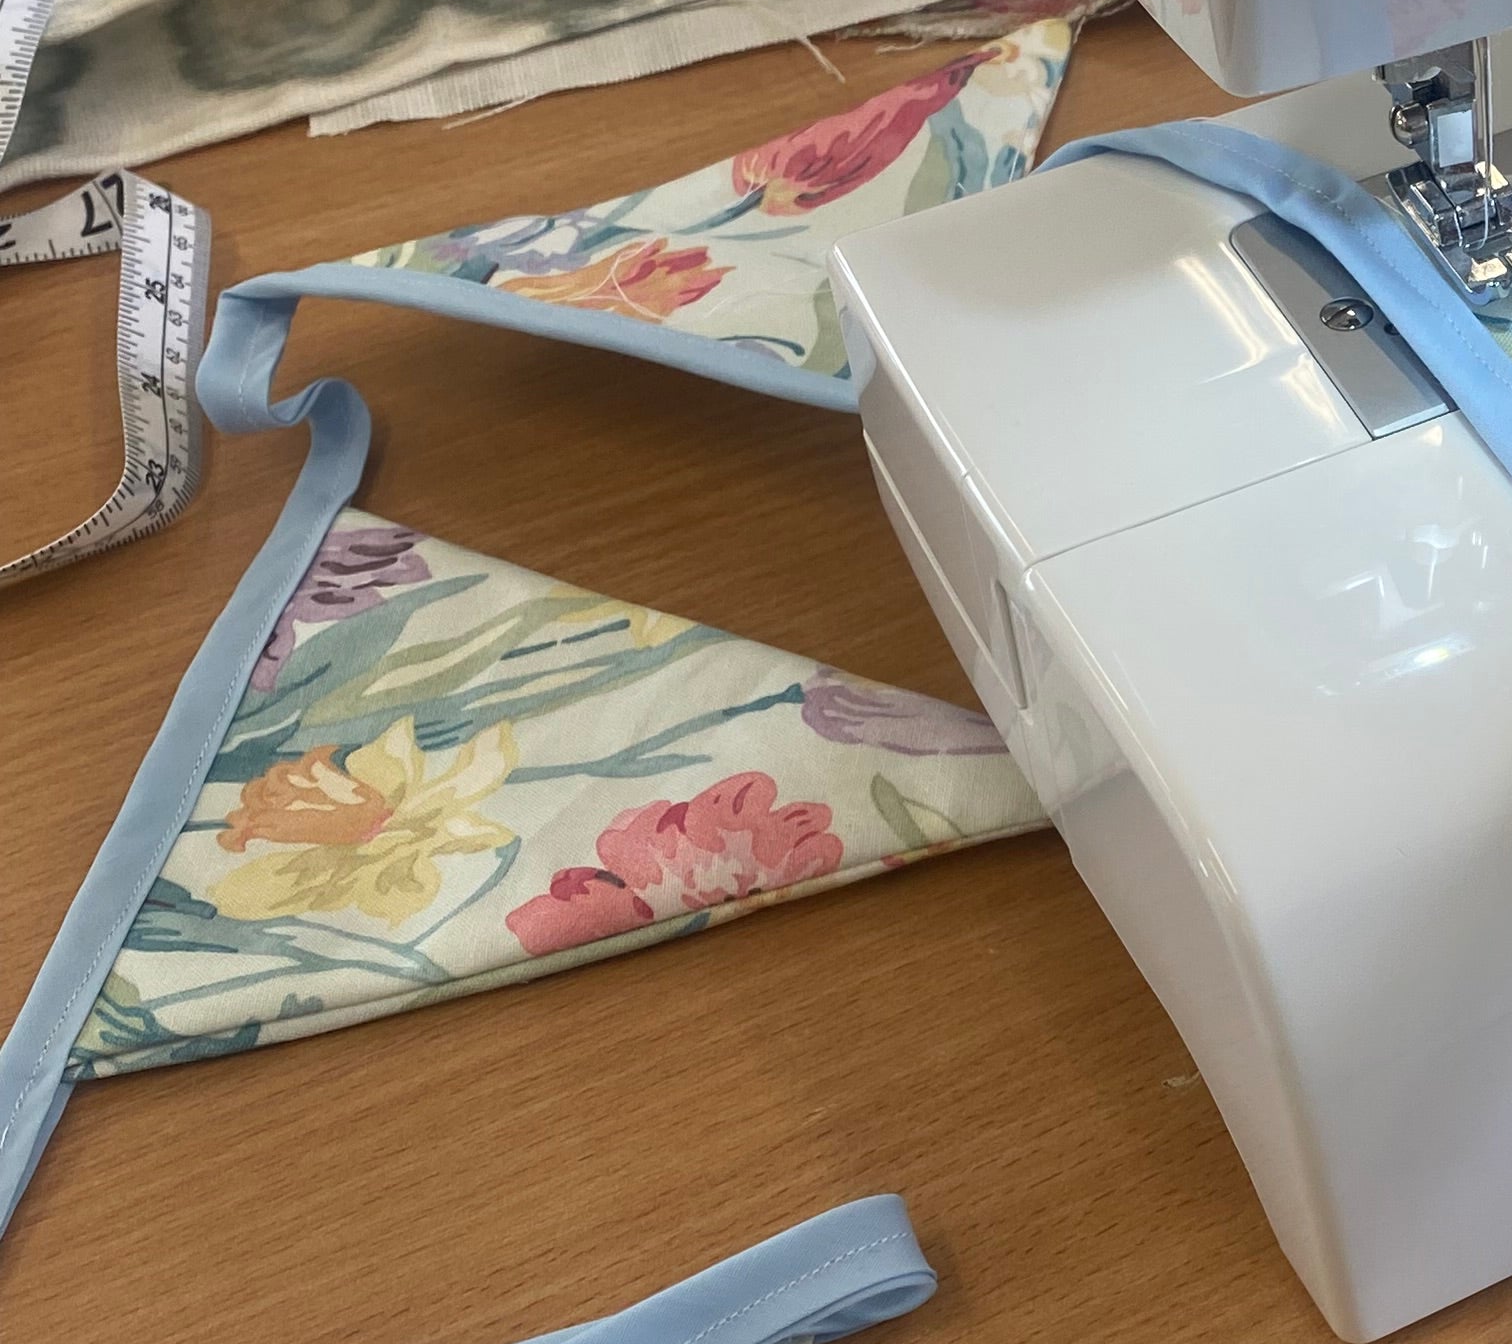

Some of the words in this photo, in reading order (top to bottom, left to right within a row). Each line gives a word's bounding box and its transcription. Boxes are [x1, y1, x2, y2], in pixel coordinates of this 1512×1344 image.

[145, 278, 167, 305] 25
[141, 372, 162, 397] 24
[146, 459, 165, 496] 23
